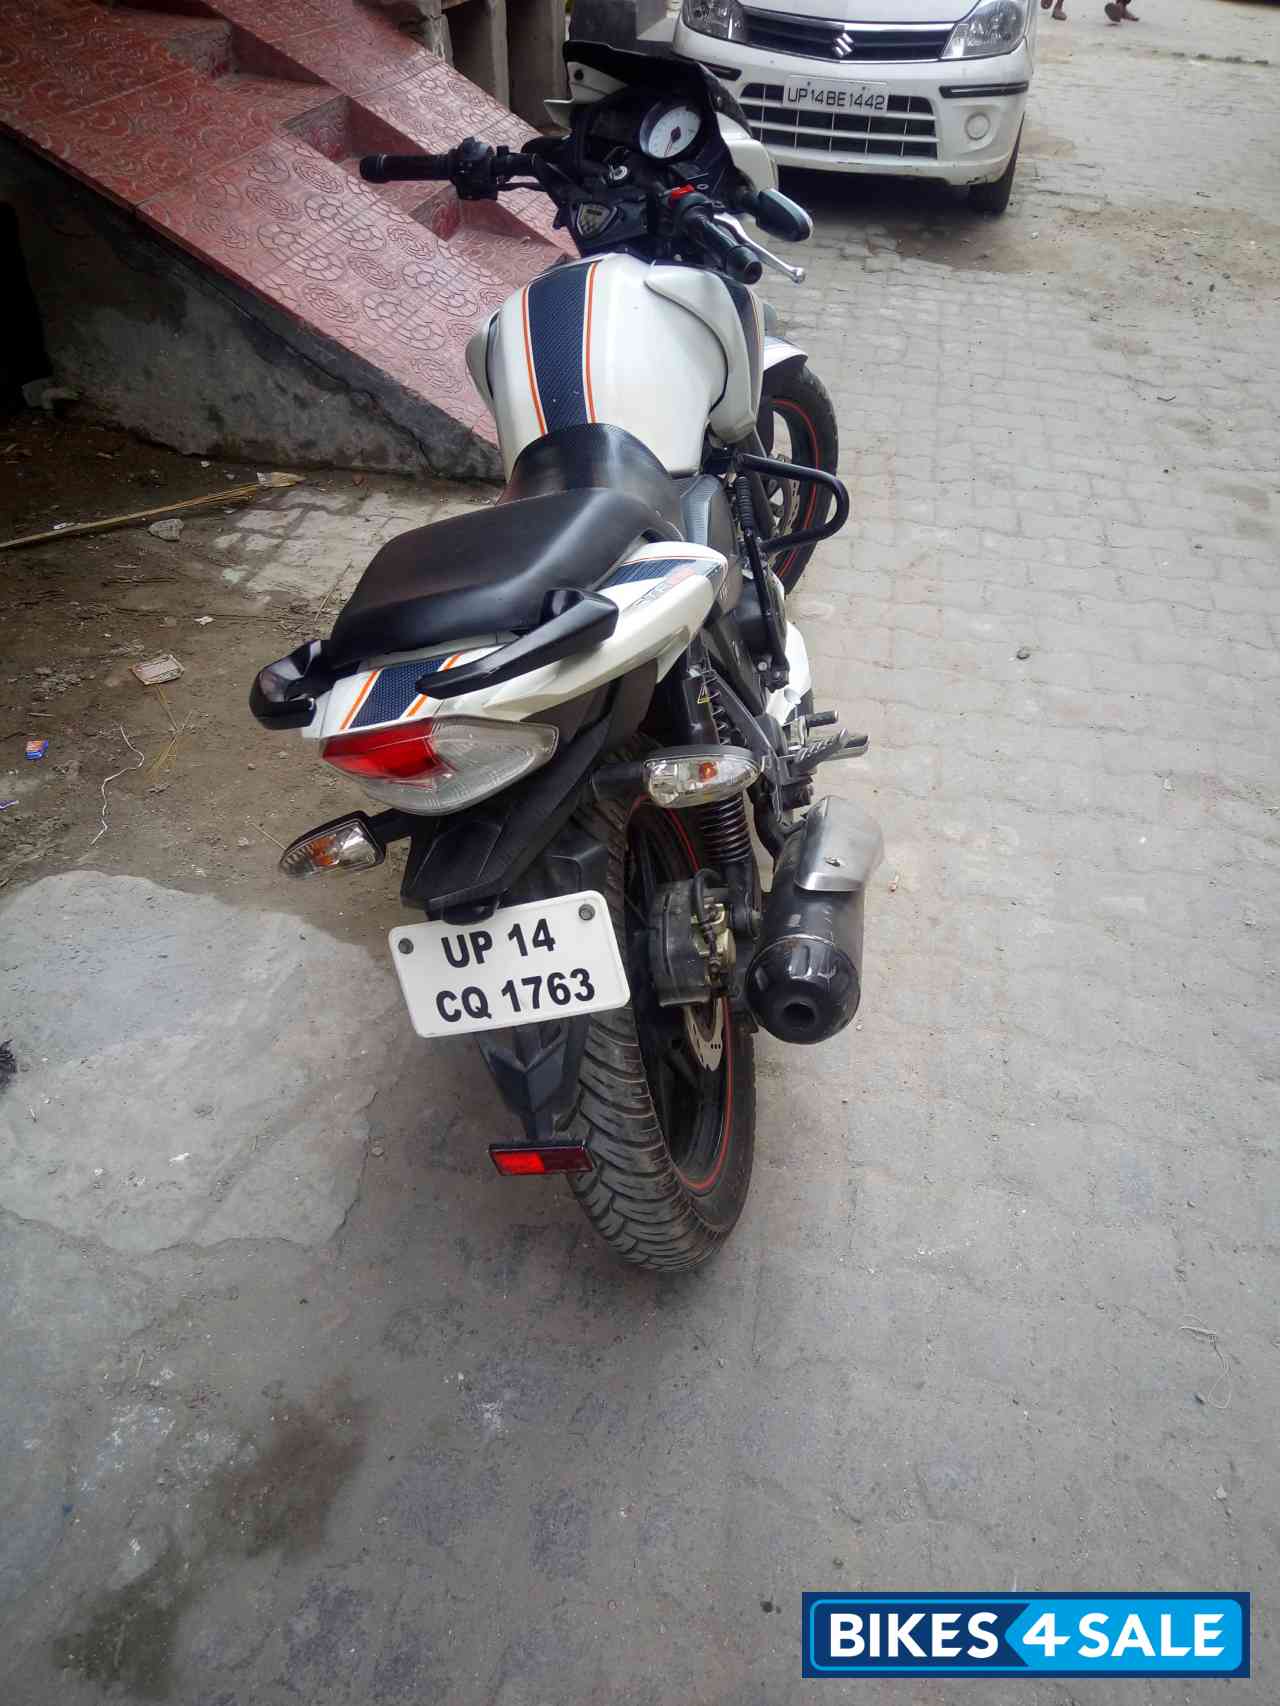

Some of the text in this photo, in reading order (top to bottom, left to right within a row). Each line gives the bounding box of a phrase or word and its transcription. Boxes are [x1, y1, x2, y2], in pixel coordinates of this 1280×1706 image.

[787, 87, 886, 110] UP14BE1442
[441, 918, 556, 968] UP 14
[436, 968, 595, 1022] CQ 1763
